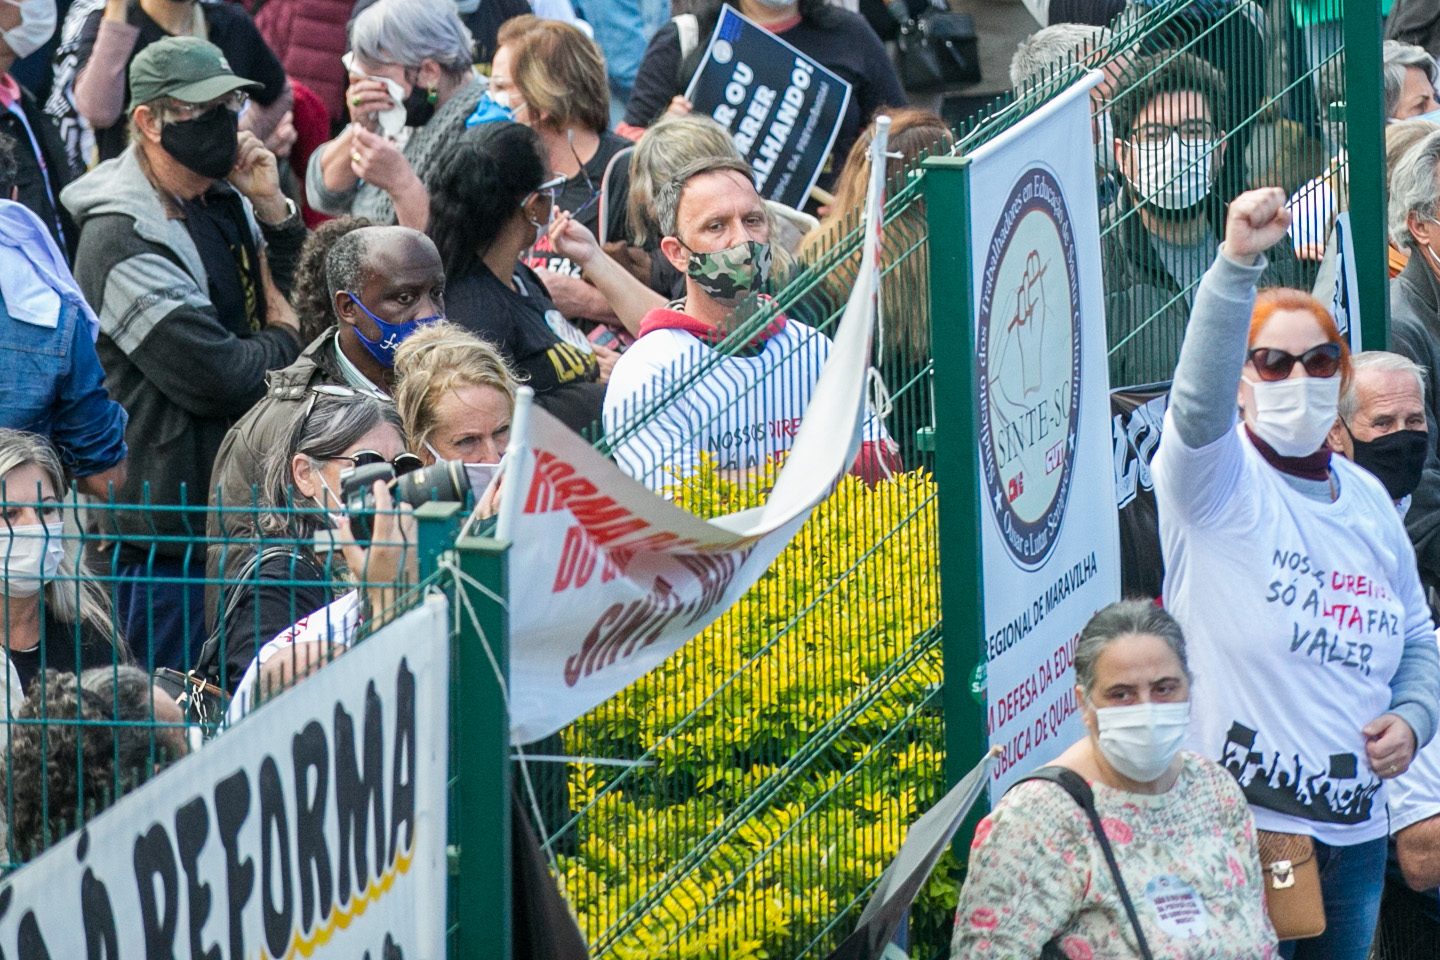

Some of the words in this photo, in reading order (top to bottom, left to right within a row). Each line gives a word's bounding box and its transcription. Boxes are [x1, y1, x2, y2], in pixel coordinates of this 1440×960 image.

[725, 61, 754, 106] OU
[734, 85, 777, 157] RRER
[753, 56, 815, 193] LHANDO!
[547, 257, 583, 280] FAZ
[981, 192, 1023, 315] Trabalhadores
[1022, 181, 1034, 204] em
[1067, 243, 1079, 306] Santa
[768, 417, 801, 439] DIRE
[998, 380, 1071, 470] SINTE-SC
[1003, 510, 1024, 554] Ousar
[985, 614, 1033, 664] REGIONAL
[1033, 596, 1044, 626] DE
[1044, 551, 1098, 616] MARAVILHA
[1266, 578, 1298, 607] SÓ
[1302, 589, 1319, 618] A
[1367, 609, 1399, 638] FAZ
[998, 673, 1039, 729] DEFESA
[1039, 658, 1053, 694] DA
[1054, 631, 1080, 680] EDUC
[1289, 621, 1373, 677] VALER
[993, 726, 1032, 781] BLICA
[1035, 711, 1048, 748] DE
[1049, 684, 1082, 738] QUALI
[133, 655, 418, 960] REFORMA
